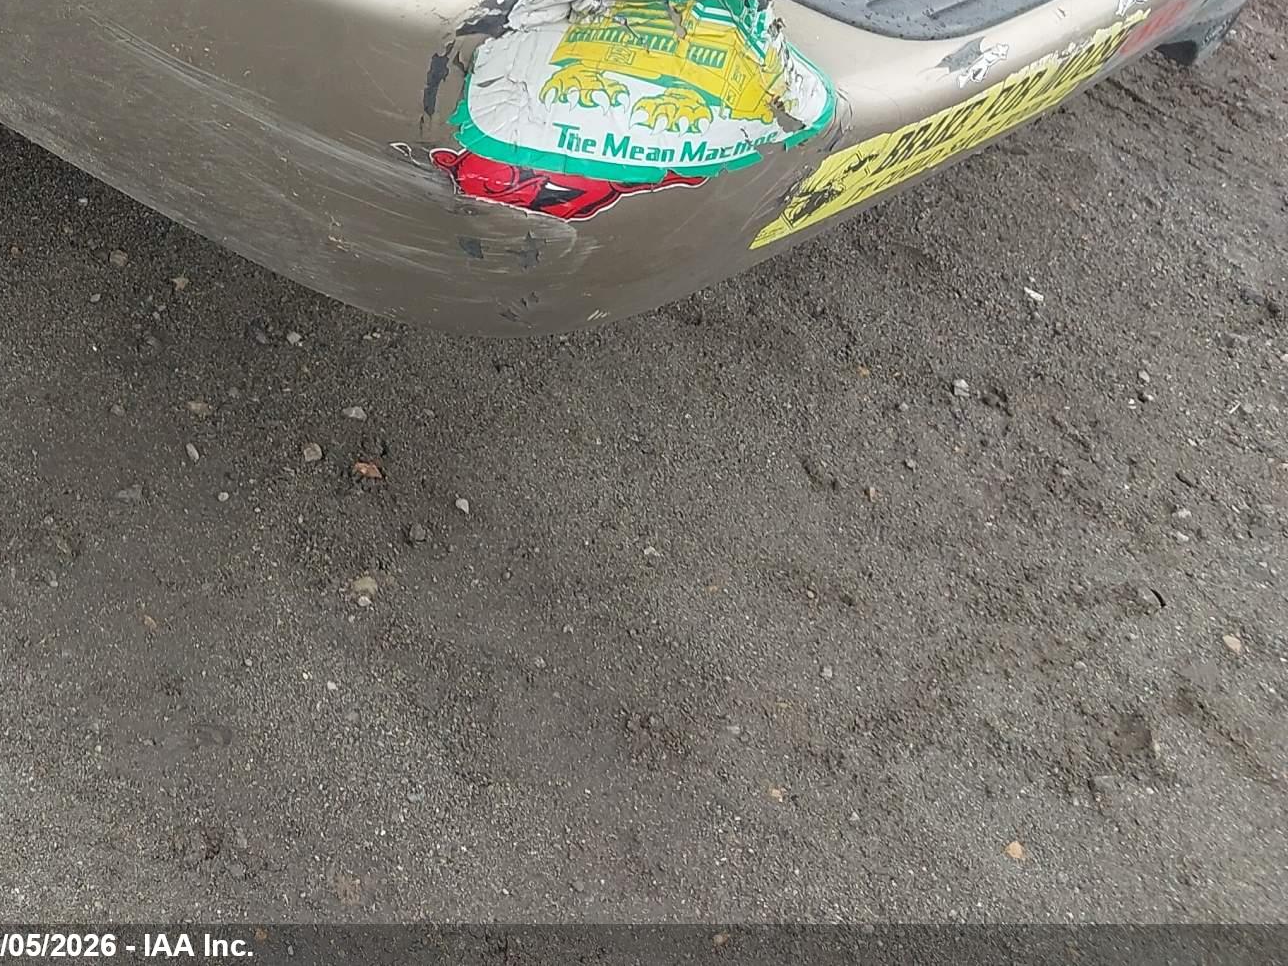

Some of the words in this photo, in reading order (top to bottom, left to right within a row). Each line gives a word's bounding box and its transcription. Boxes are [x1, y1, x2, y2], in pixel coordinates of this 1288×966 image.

[551, 121, 598, 155] The
[601, 133, 676, 164] Mean
[869, 95, 991, 177] BRAKE
